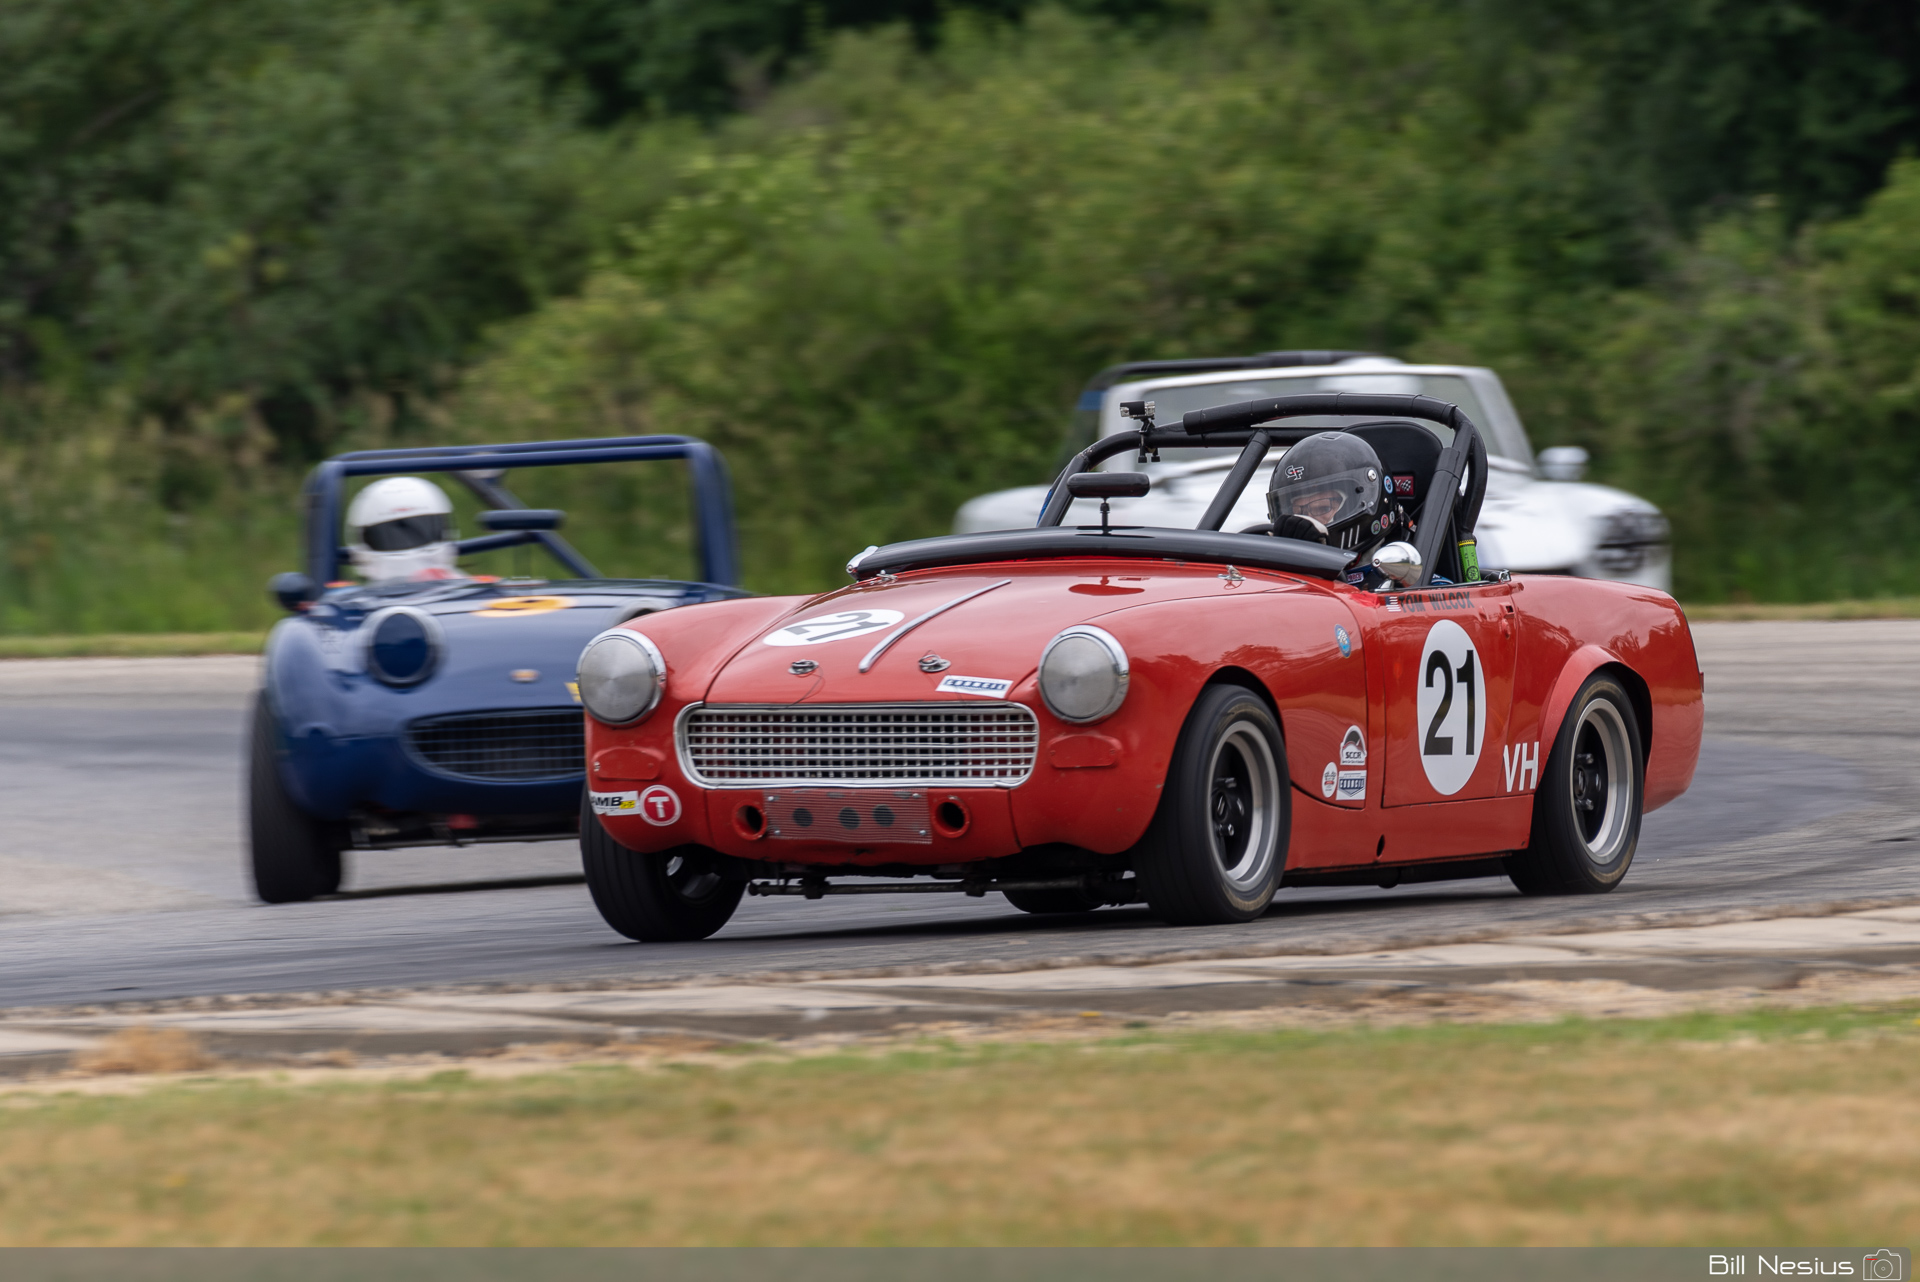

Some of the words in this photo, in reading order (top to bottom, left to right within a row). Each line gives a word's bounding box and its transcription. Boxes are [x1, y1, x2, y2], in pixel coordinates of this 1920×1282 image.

[1398, 594, 1426, 613] TOM
[1428, 591, 1475, 611] WILCOX
[784, 612, 890, 642] 21
[1423, 649, 1475, 756] 21
[1503, 741, 1540, 793] VH
[648, 796, 670, 819] T
